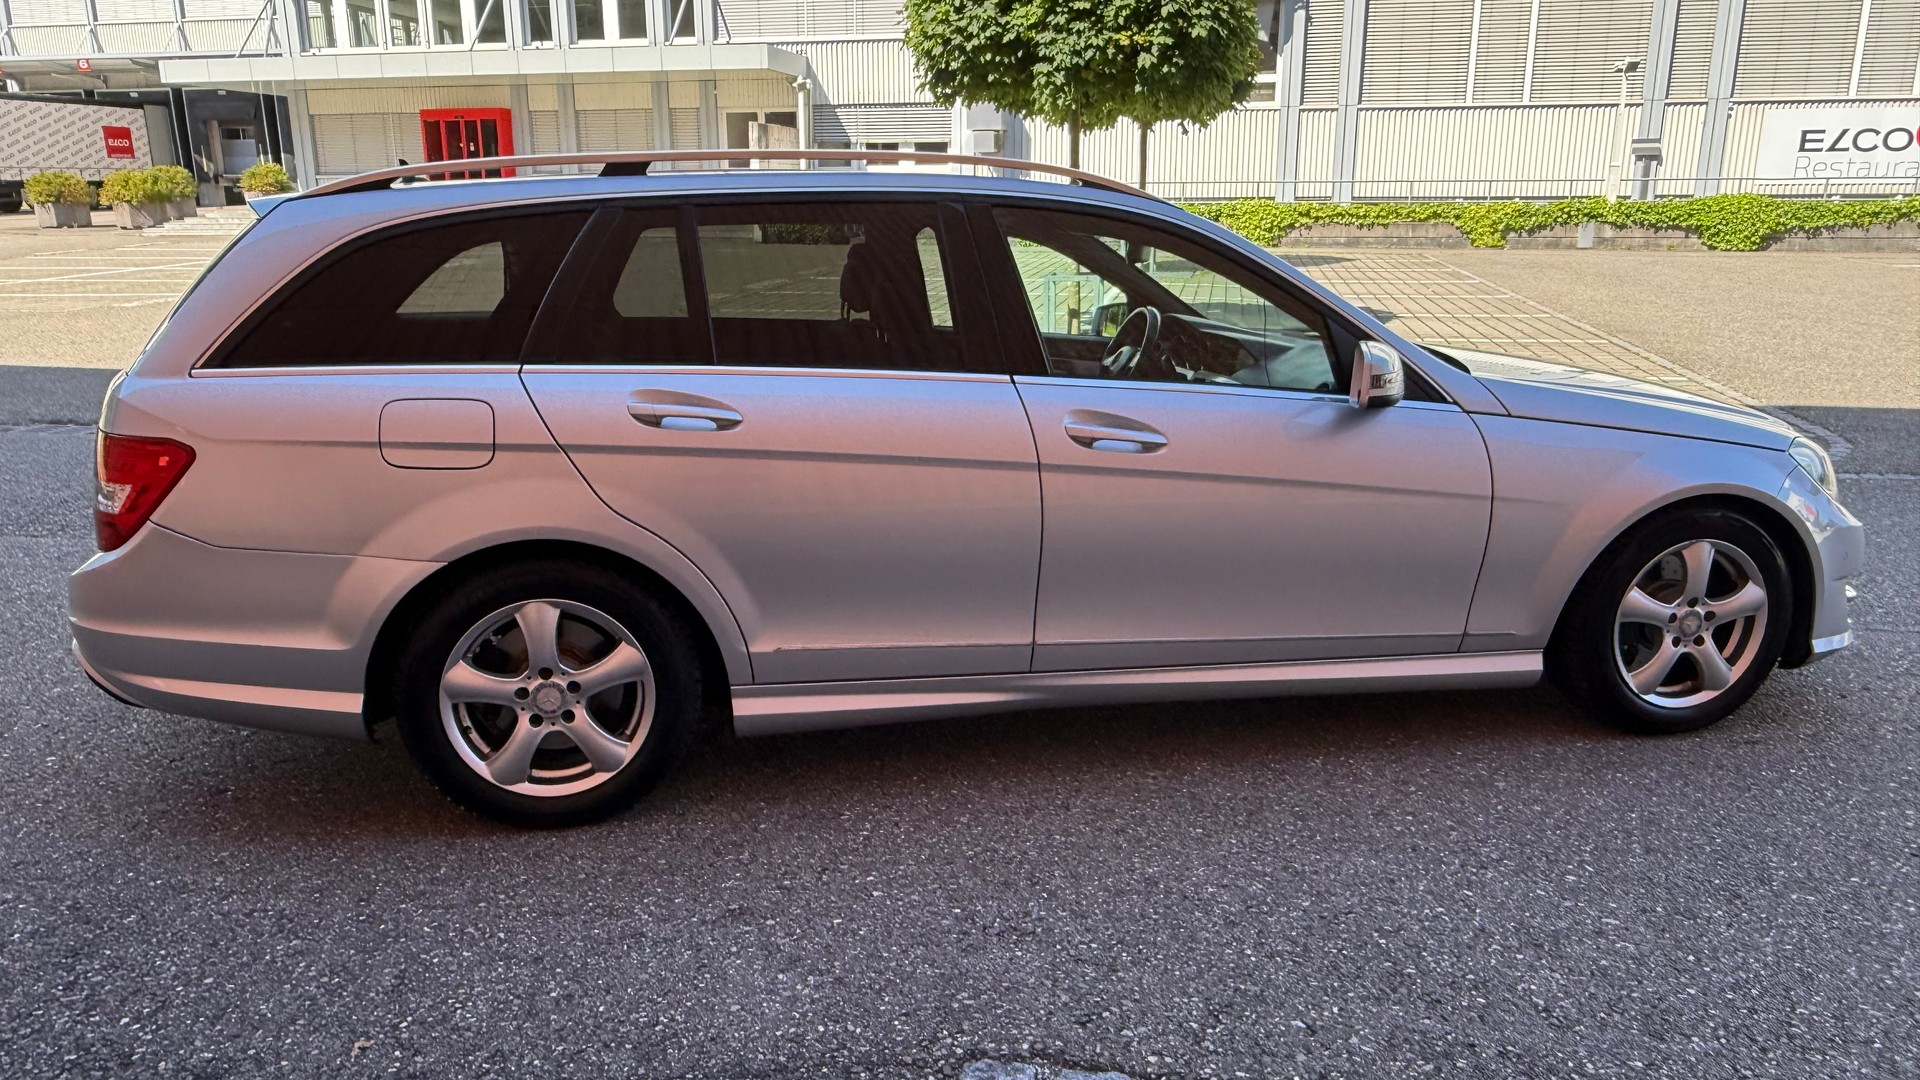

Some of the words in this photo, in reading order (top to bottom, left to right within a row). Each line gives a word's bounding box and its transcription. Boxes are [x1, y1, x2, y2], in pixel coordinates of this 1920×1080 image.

[79, 59, 89, 69] 6
[107, 138, 130, 147] ELCO
[1798, 127, 1914, 152] ELCO
